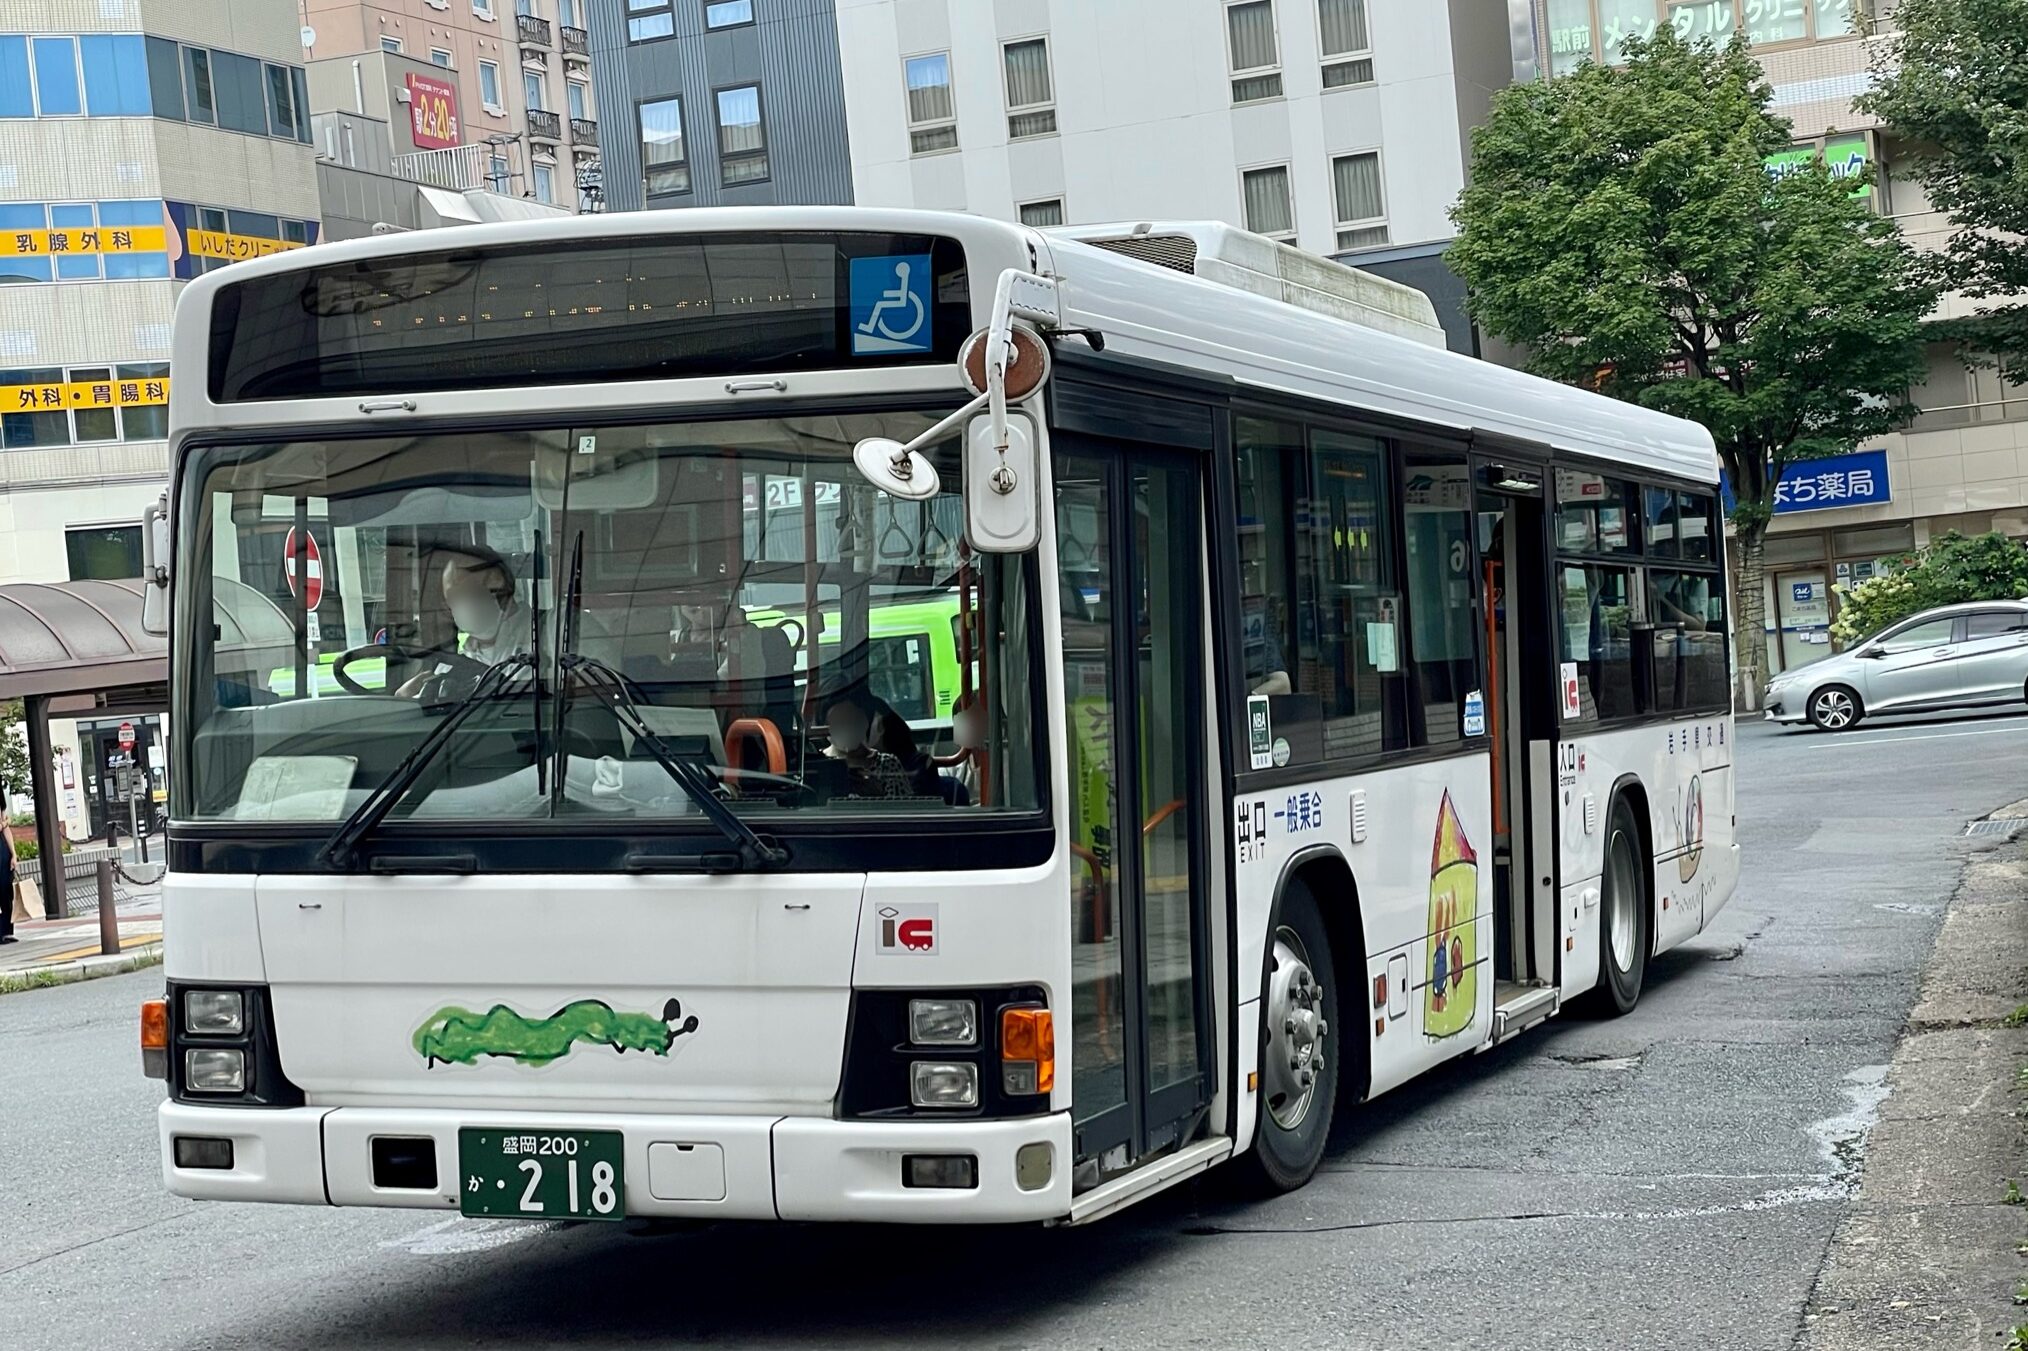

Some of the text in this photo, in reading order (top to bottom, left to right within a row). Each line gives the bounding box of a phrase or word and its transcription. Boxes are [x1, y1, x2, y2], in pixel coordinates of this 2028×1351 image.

[1552, 25, 1590, 53] 駅前
[16, 231, 133, 253] 乳腺外科
[19, 382, 165, 408] 外科・胃腸科
[767, 481, 796, 507] 2F
[1773, 469, 1874, 505] まち薬局
[1252, 711, 1267, 729] NBA
[1560, 743, 1575, 771] 入口
[1237, 791, 1323, 845] 出口 一般乗合
[1240, 842, 1266, 863] EXIT
[468, 1175, 484, 1192] か
